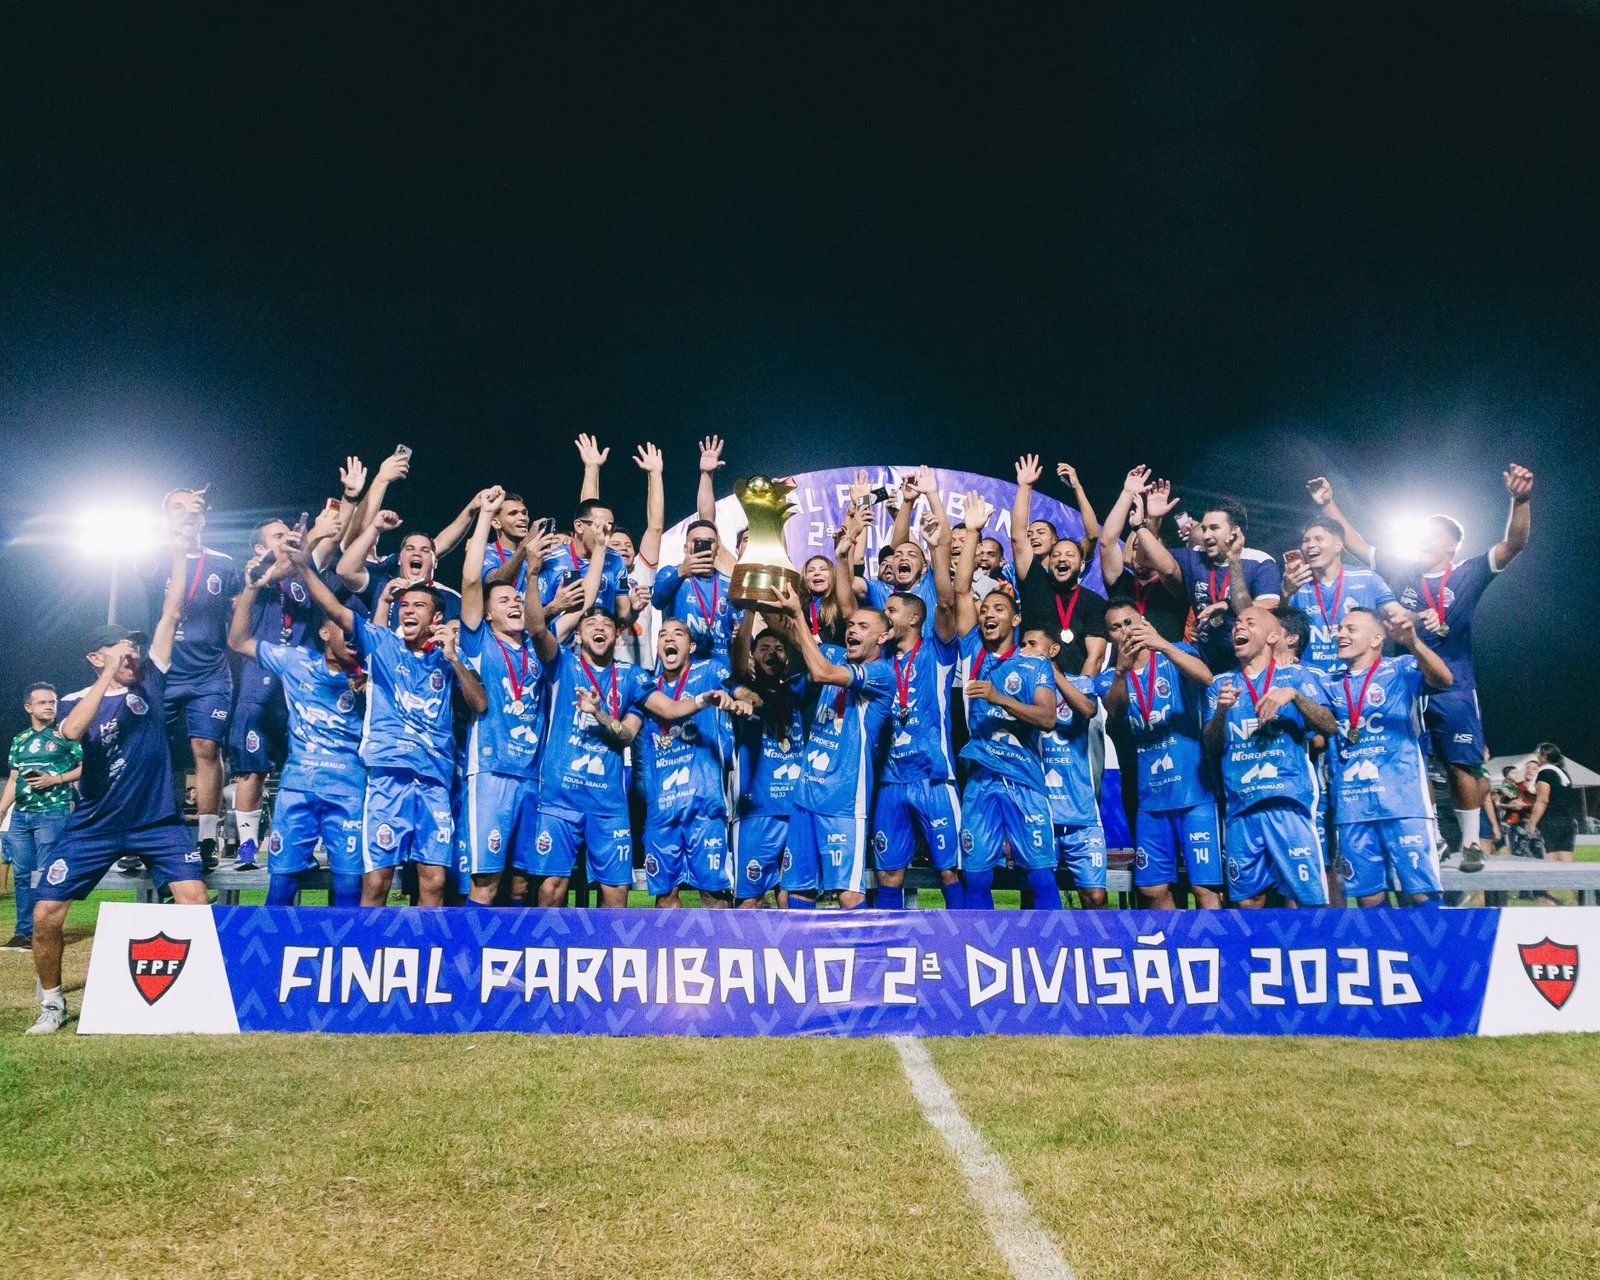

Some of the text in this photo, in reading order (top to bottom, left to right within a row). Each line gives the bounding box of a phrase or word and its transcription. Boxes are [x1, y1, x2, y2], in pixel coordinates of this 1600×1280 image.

[342, 820, 362, 829] NPC
[613, 829, 631, 839] NPC
[827, 834, 847, 842] NPC
[936, 834, 946, 850] 3
[1032, 830, 1043, 847] 5
[1189, 832, 1210, 841] NPC
[1399, 835, 1424, 845] NPC
[346, 836, 357, 853] 9
[704, 838, 723, 847] NPC
[829, 850, 843, 867] 10
[1089, 852, 1103, 868] 18
[1193, 847, 1210, 864] 14
[1288, 847, 1312, 857] NPC
[707, 853, 721, 870] 16
[1408, 851, 1419, 870] 7
[1297, 863, 1309, 881] 6
[136, 960, 179, 975] FPF
[278, 931, 1423, 1008] FINAL PARAIBANO 2ª DIVISÃO 2026
[1531, 964, 1575, 979] FPF
